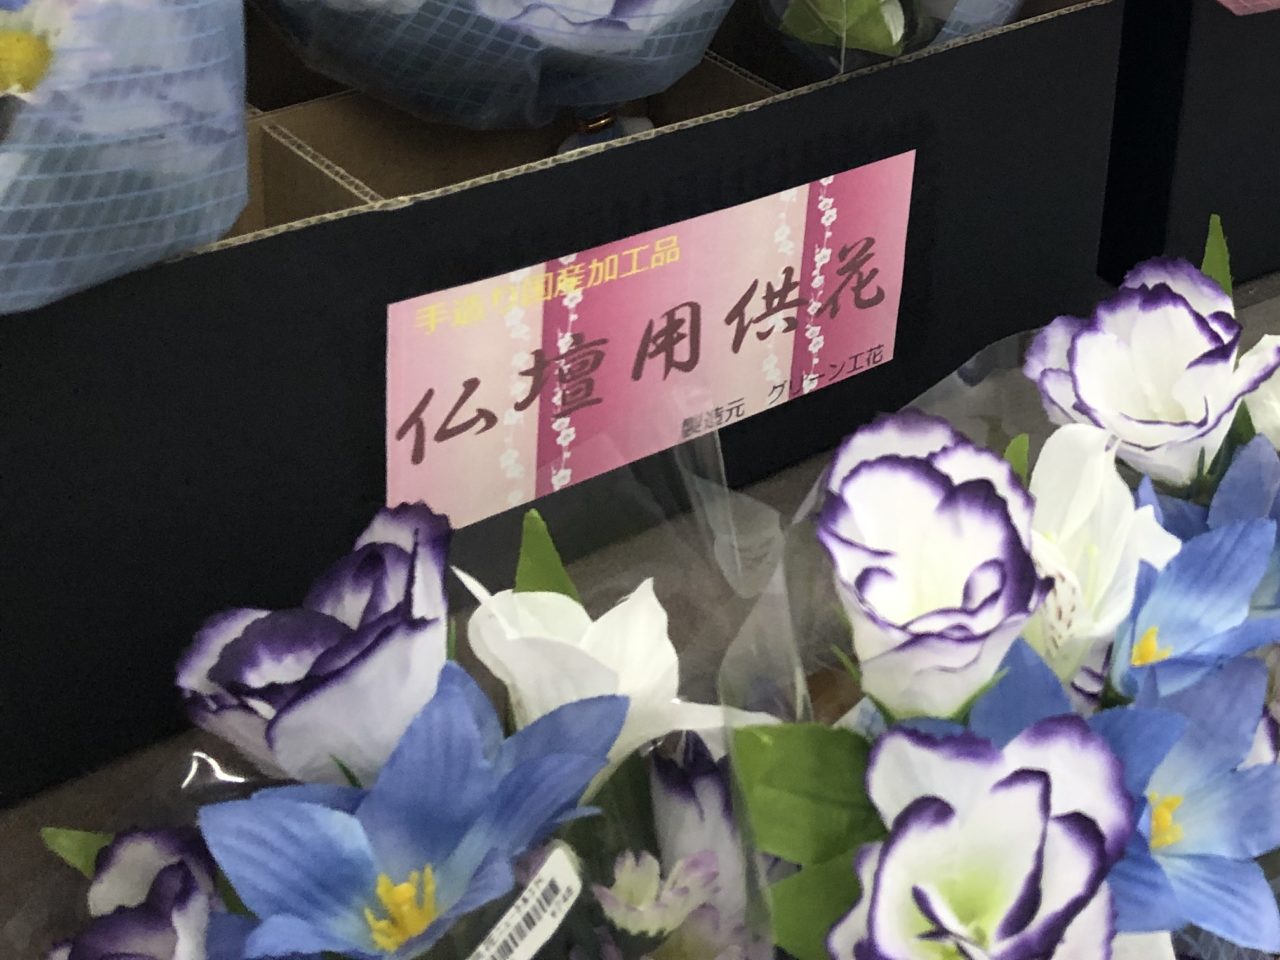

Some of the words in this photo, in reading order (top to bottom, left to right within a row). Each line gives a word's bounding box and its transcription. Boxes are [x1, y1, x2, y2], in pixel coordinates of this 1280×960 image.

[415, 235, 681, 336] 手造り国産加工品
[395, 236, 886, 467] 仏壇用供花
[681, 397, 745, 439] 製造元
